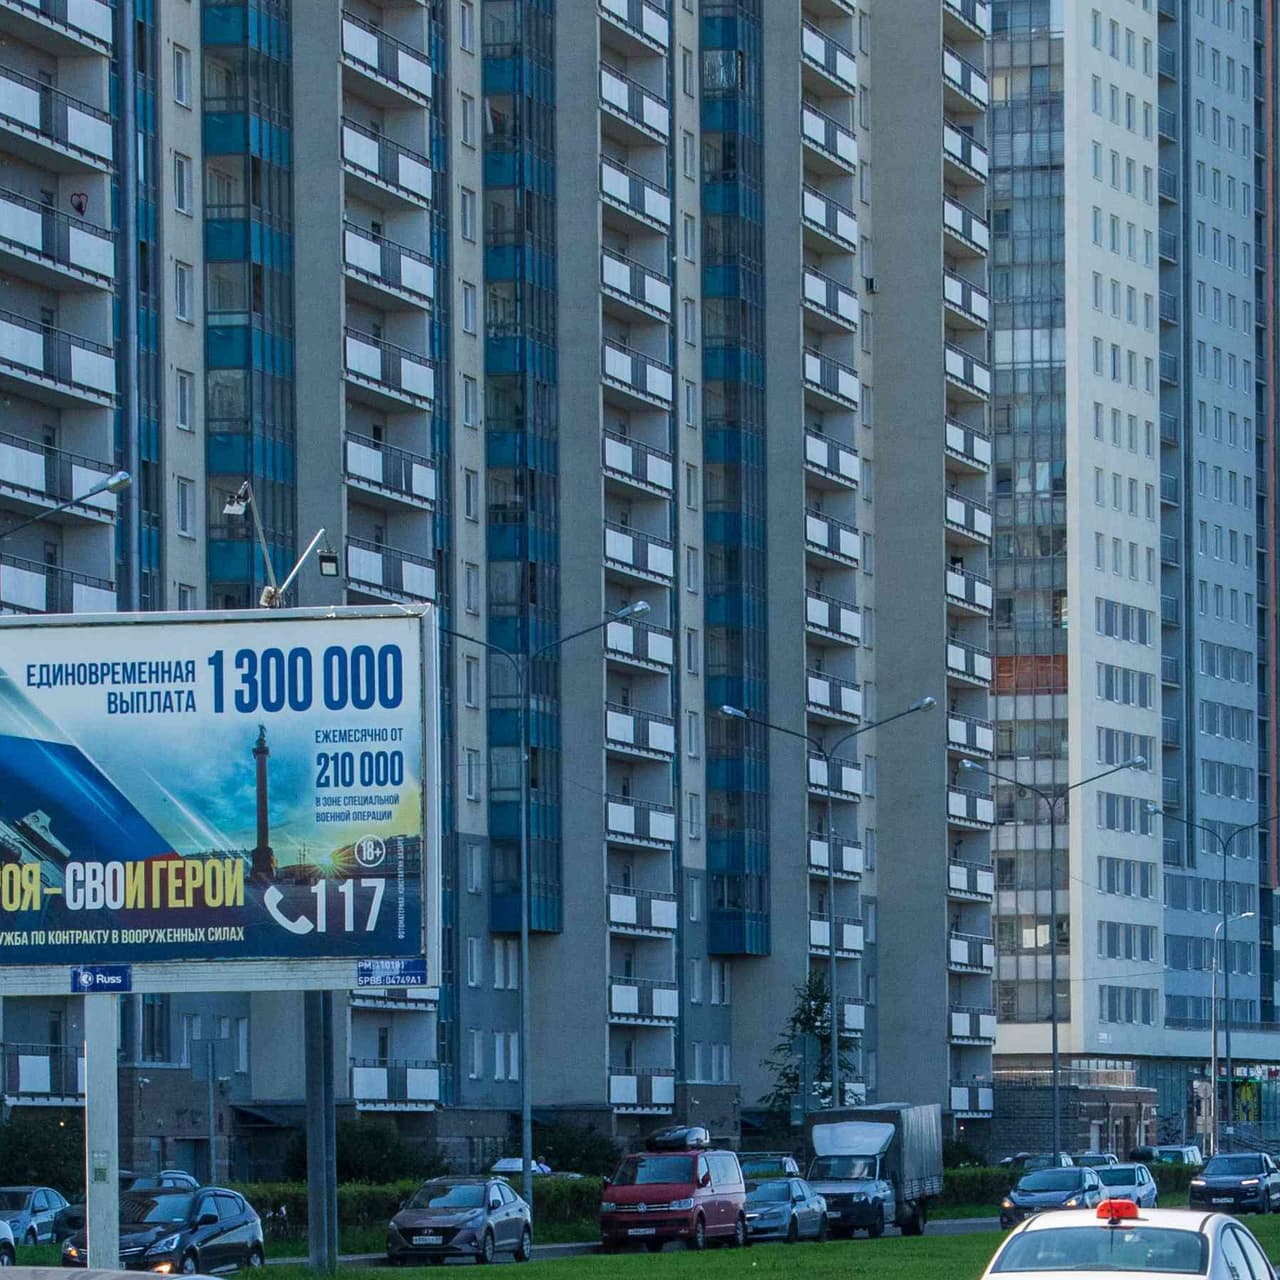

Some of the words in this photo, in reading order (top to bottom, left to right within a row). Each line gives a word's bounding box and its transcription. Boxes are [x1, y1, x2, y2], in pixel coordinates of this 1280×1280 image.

[26, 660, 196, 688] ЕДИНОВРЕМЕННАЯ
[207, 649, 224, 713] 1
[234, 646, 313, 713] 300
[323, 644, 403, 711] 000
[107, 690, 196, 714] ВЫПЛАТА
[315, 728, 388, 744] ЕЖЕМЕСЯЧНО
[390, 727, 403, 742] ОТ
[315, 752, 354, 788] 210
[359, 750, 404, 787] 000
[322, 796, 342, 807] ЗОНЕ
[343, 793, 400, 806] СПЕЦИАЛЬНОЙ
[316, 810, 351, 822] ВОЕННОЙ
[352, 810, 393, 821] ОПЕРАЦИИ
[360, 841, 383, 862] 18+
[65, 861, 145, 910] СВОИ
[152, 858, 245, 909] ГЕРОИ
[310, 877, 386, 932] 117
[31, 930, 46, 945] ПО
[48, 929, 109, 945] КОНТРАКТУ
[112, 929, 119, 943] В
[121, 927, 205, 943] ВООРУЖЕННЫХ
[208, 926, 245, 942] СИЛАХ
[96, 974, 122, 984] Russ
